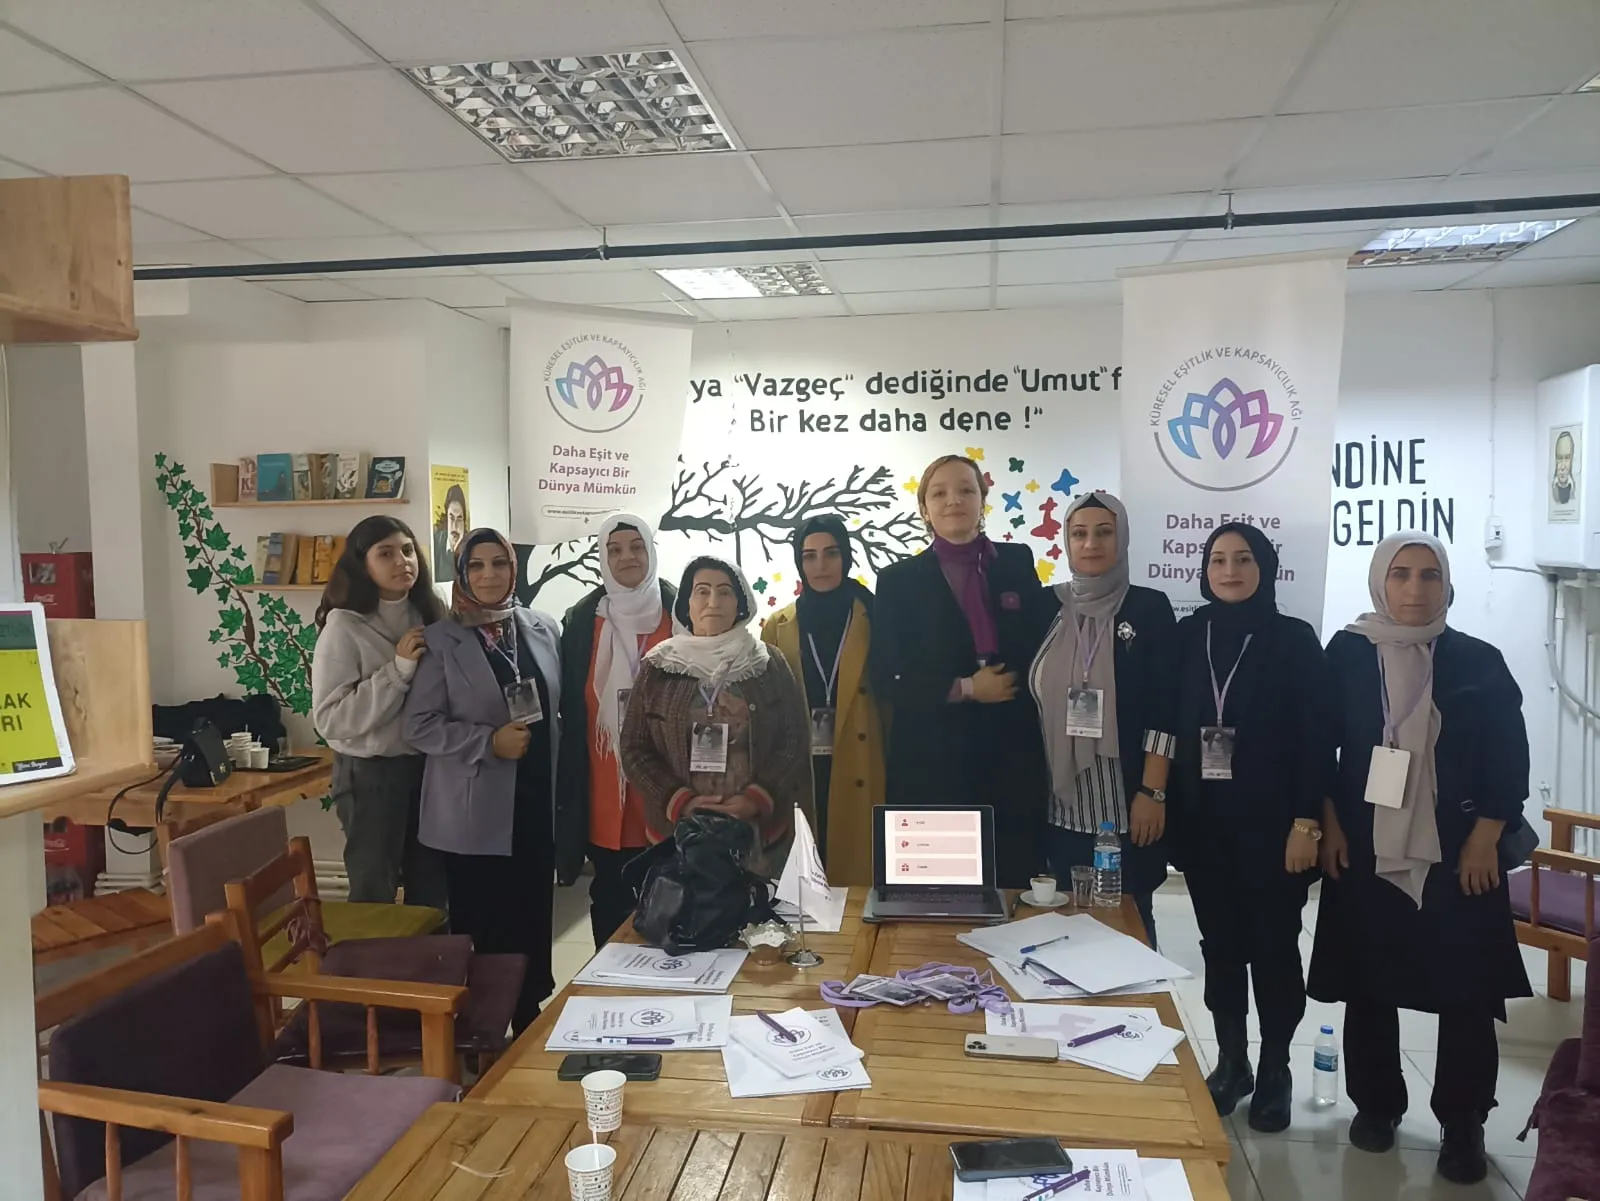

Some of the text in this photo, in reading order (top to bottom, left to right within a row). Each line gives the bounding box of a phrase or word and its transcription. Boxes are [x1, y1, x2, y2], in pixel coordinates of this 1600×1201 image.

[690, 377, 723, 403] ya
[865, 370, 1009, 400] dediğinde
[1150, 347, 1303, 426] KÜRESEL EŞİTLİK VE KAPSAYICILIK AĞI
[750, 409, 788, 433] Bir
[799, 409, 849, 433] kez
[859, 408, 928, 432] daha
[939, 406, 1011, 432] dene
[552, 445, 630, 463] Daha Eşit ve
[549, 462, 630, 478] Kapsayıcı Bir
[538, 479, 636, 495] Dünya Mümkün
[1166, 514, 1214, 529] Daha
[1260, 516, 1281, 529] ve
